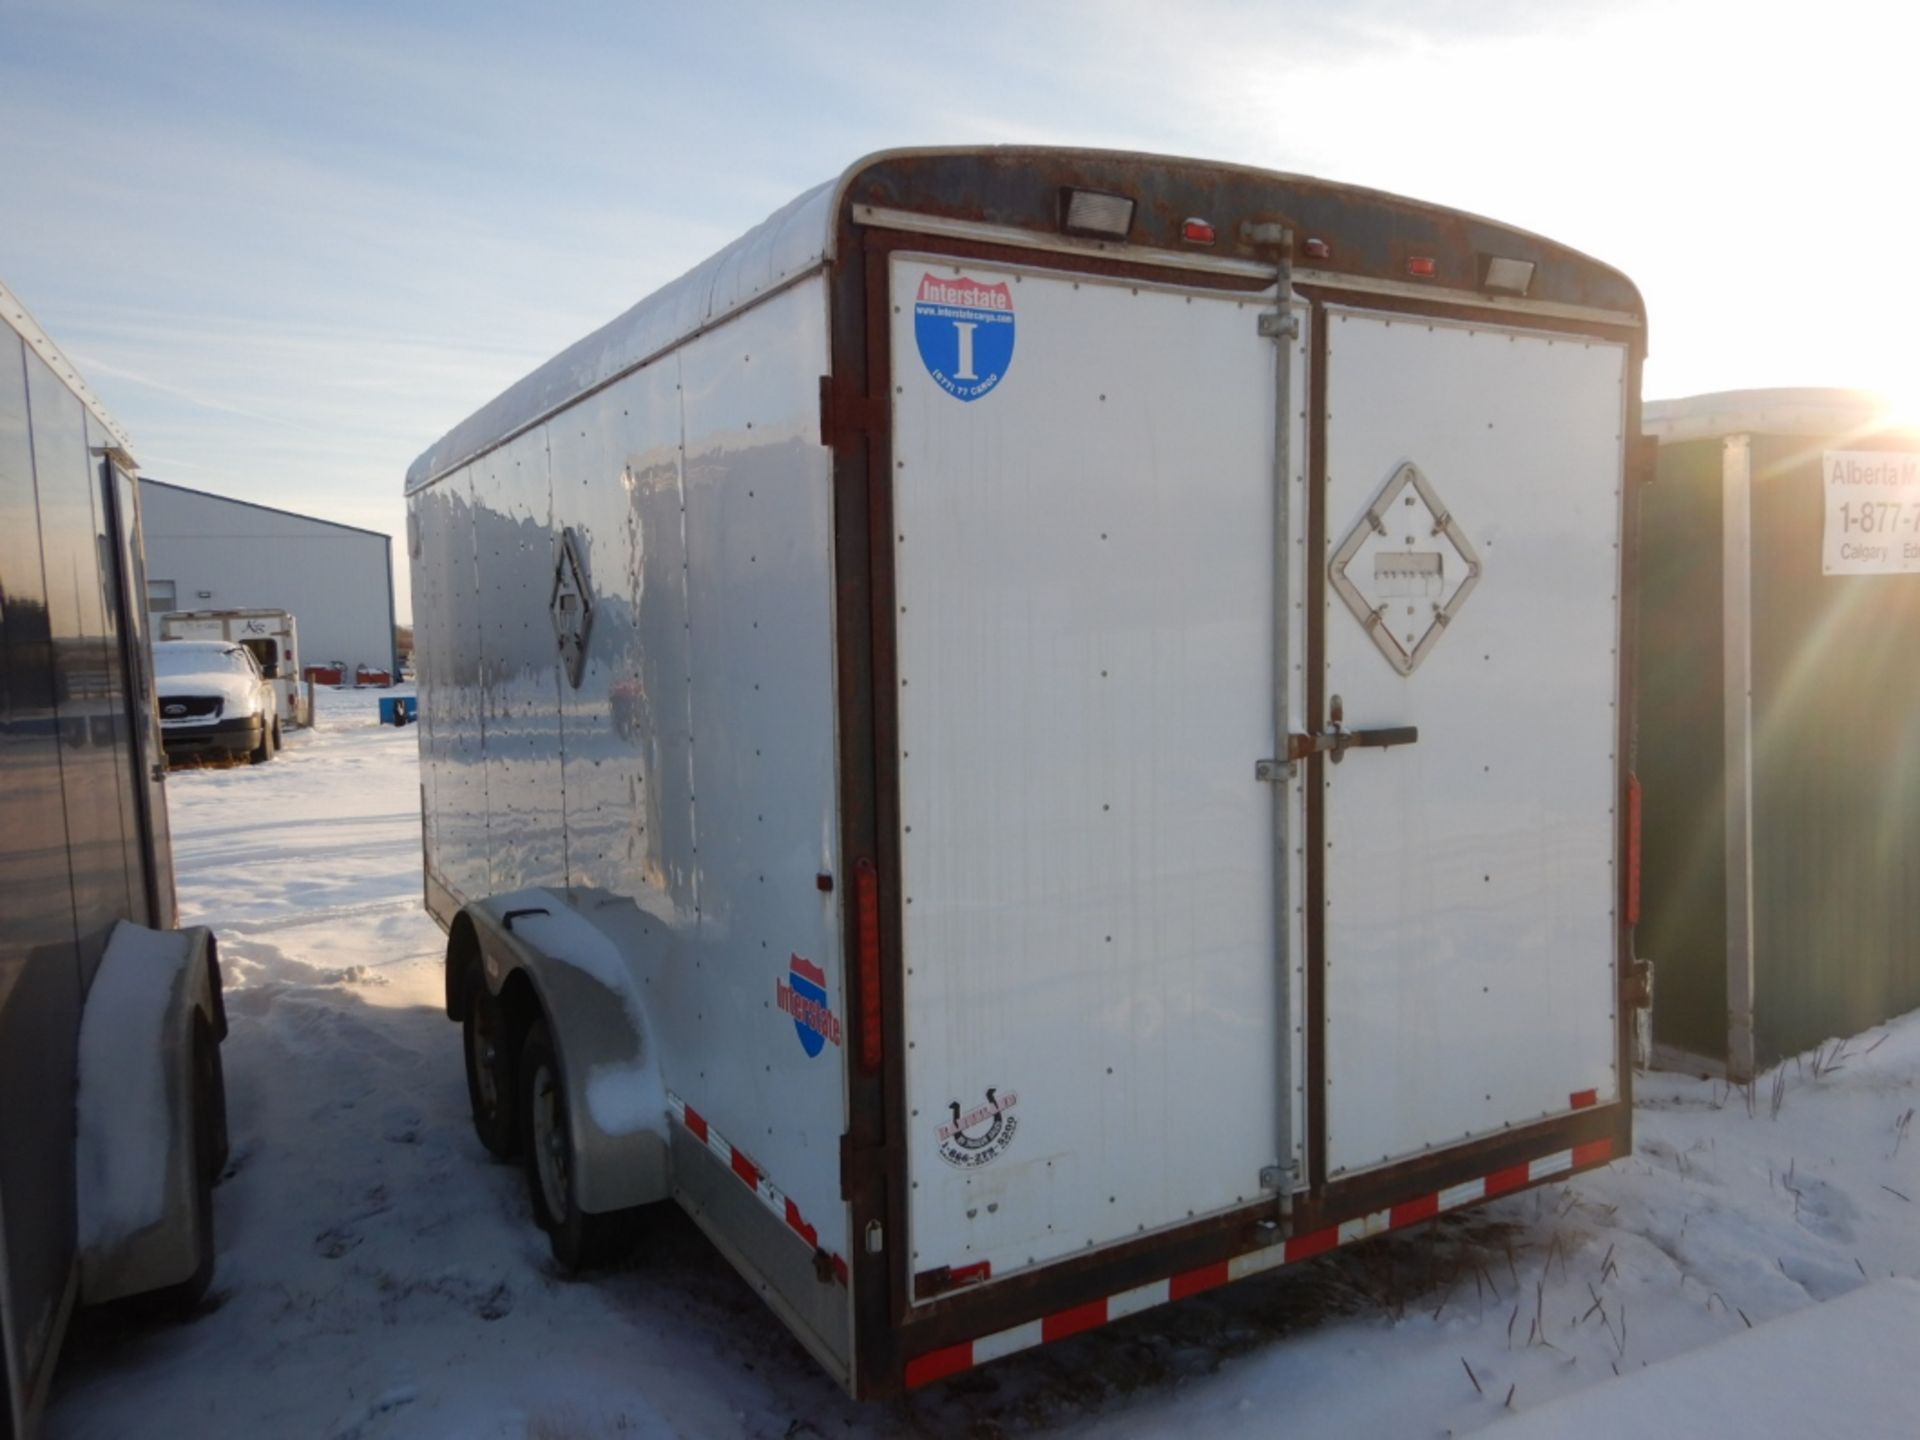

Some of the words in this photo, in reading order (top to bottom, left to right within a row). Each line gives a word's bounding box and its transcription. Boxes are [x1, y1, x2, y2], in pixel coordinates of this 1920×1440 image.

[922, 281, 1006, 309] Interstate
[916, 306, 1013, 323] www.interstatecargo.com
[1830, 459, 1899, 486] Alberta
[1840, 542, 1888, 562] Calgary
[776, 975, 841, 1048] Interstate
